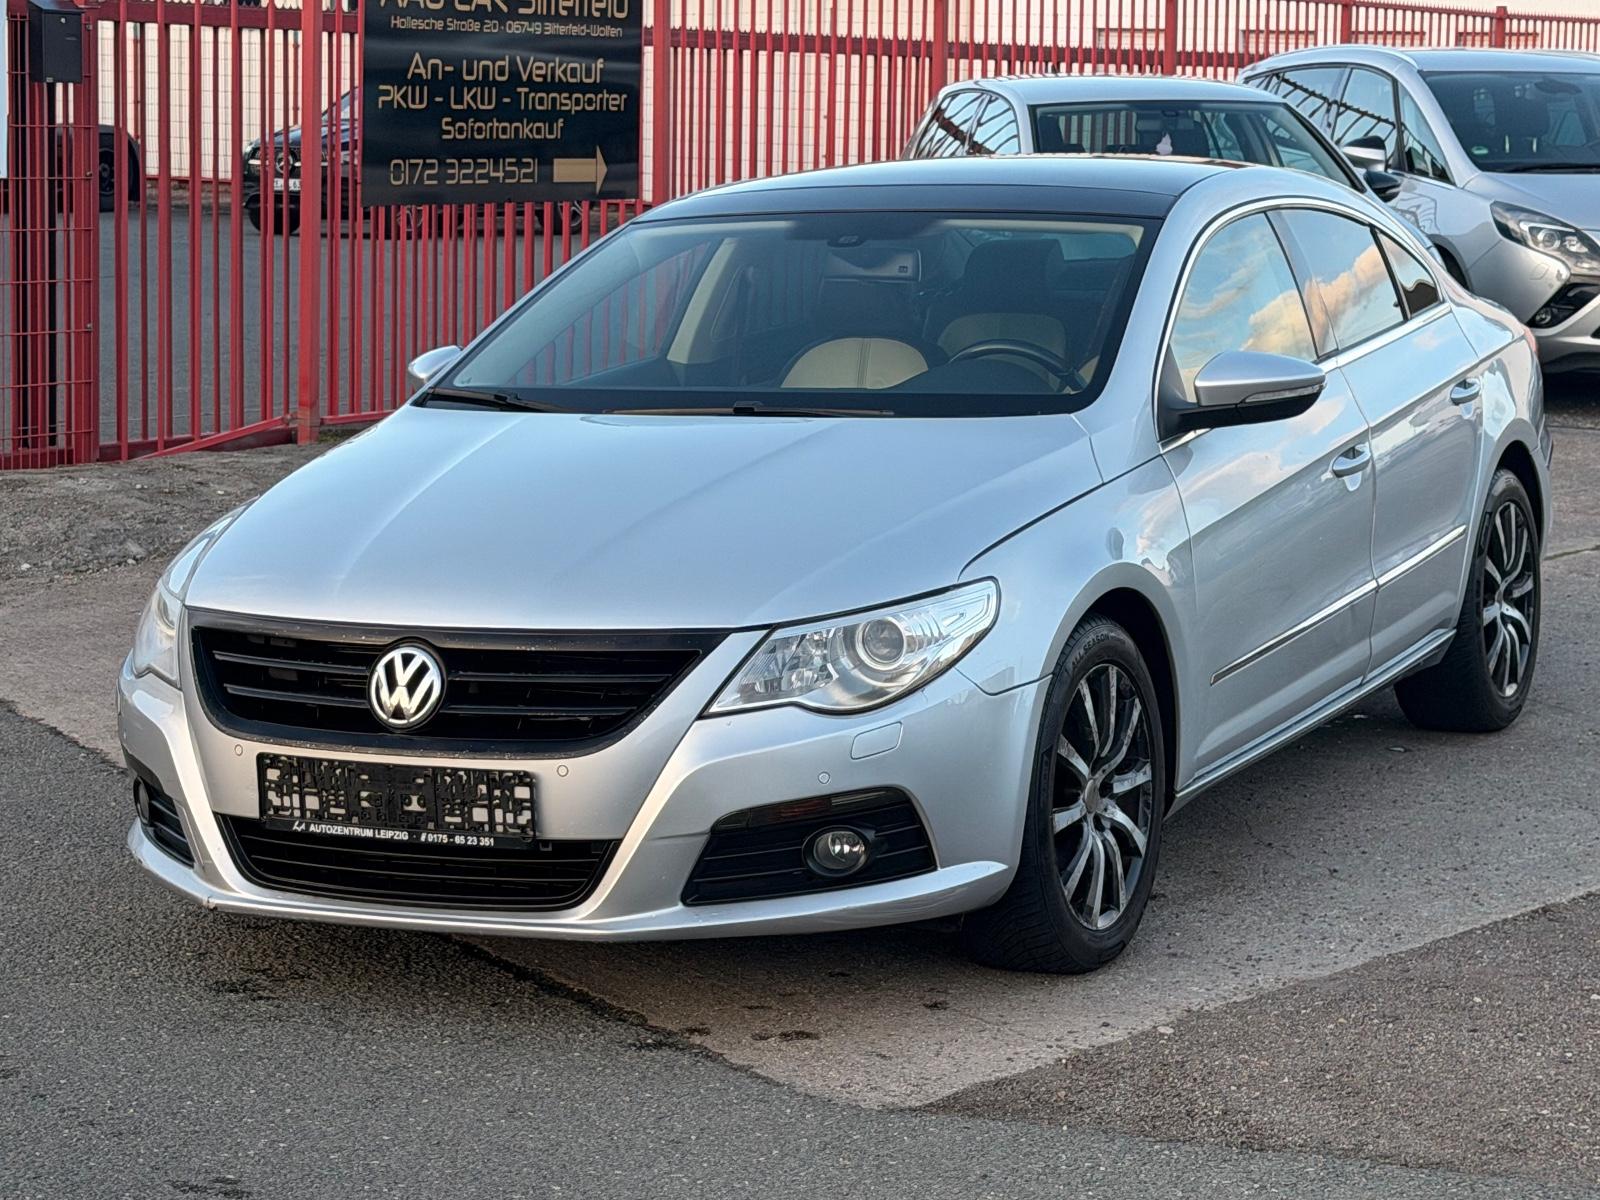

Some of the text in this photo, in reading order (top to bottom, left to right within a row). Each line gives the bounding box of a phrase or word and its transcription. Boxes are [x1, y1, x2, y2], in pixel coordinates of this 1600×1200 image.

[483, 19, 499, 33] 20
[505, 20, 542, 35] 06749
[543, 22, 623, 38] Bitterfeld-Wolfen
[407, 52, 605, 83] An- und Verkauf
[378, 84, 428, 109] PKW
[450, 86, 497, 110] LKW
[516, 87, 628, 115] Transporter
[441, 117, 564, 140] Sofortankauf
[390, 158, 538, 185] 0172 3224521
[309, 823, 374, 837] AUTOZENTRUM
[375, 829, 409, 840] LEIPZIG
[427, 833, 448, 844] 0175
[467, 836, 479, 846] 23
[479, 837, 495, 847] 351
